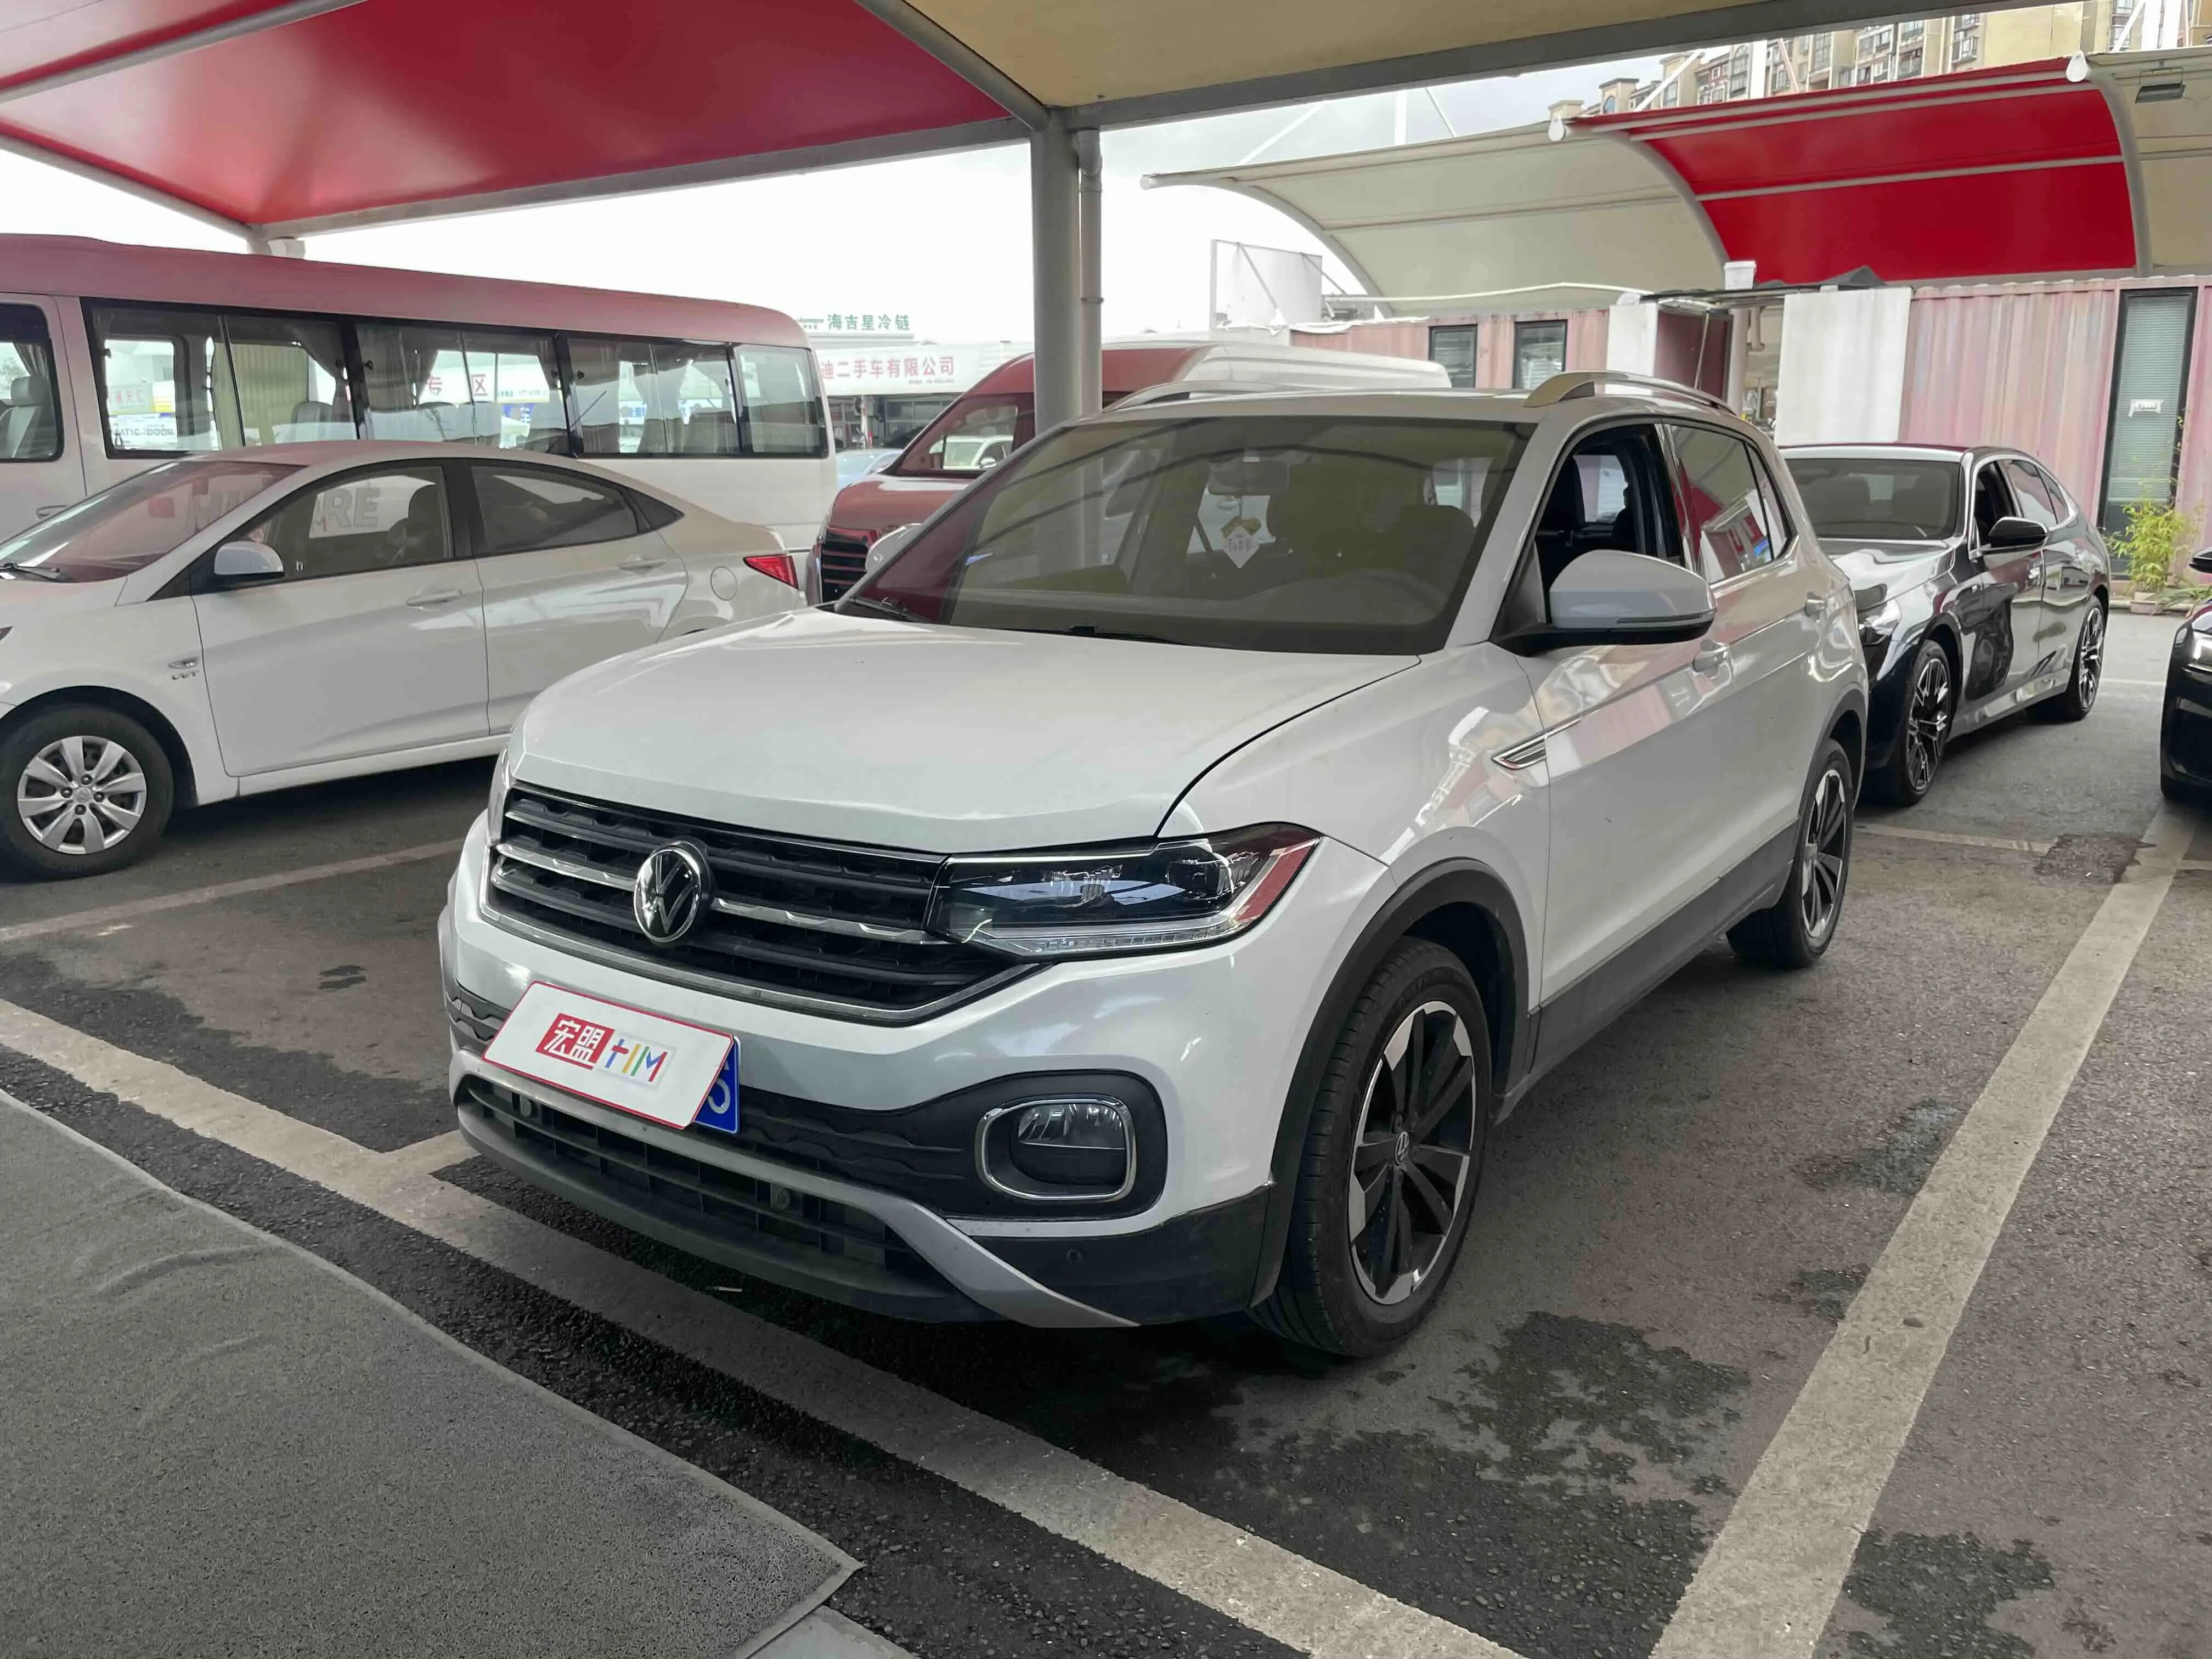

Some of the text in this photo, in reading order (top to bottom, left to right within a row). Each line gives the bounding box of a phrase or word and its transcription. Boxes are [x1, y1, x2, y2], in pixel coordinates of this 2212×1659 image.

[827, 314, 910, 330] 海吉星冷链
[821, 356, 955, 379] 迪二手车有限公司
